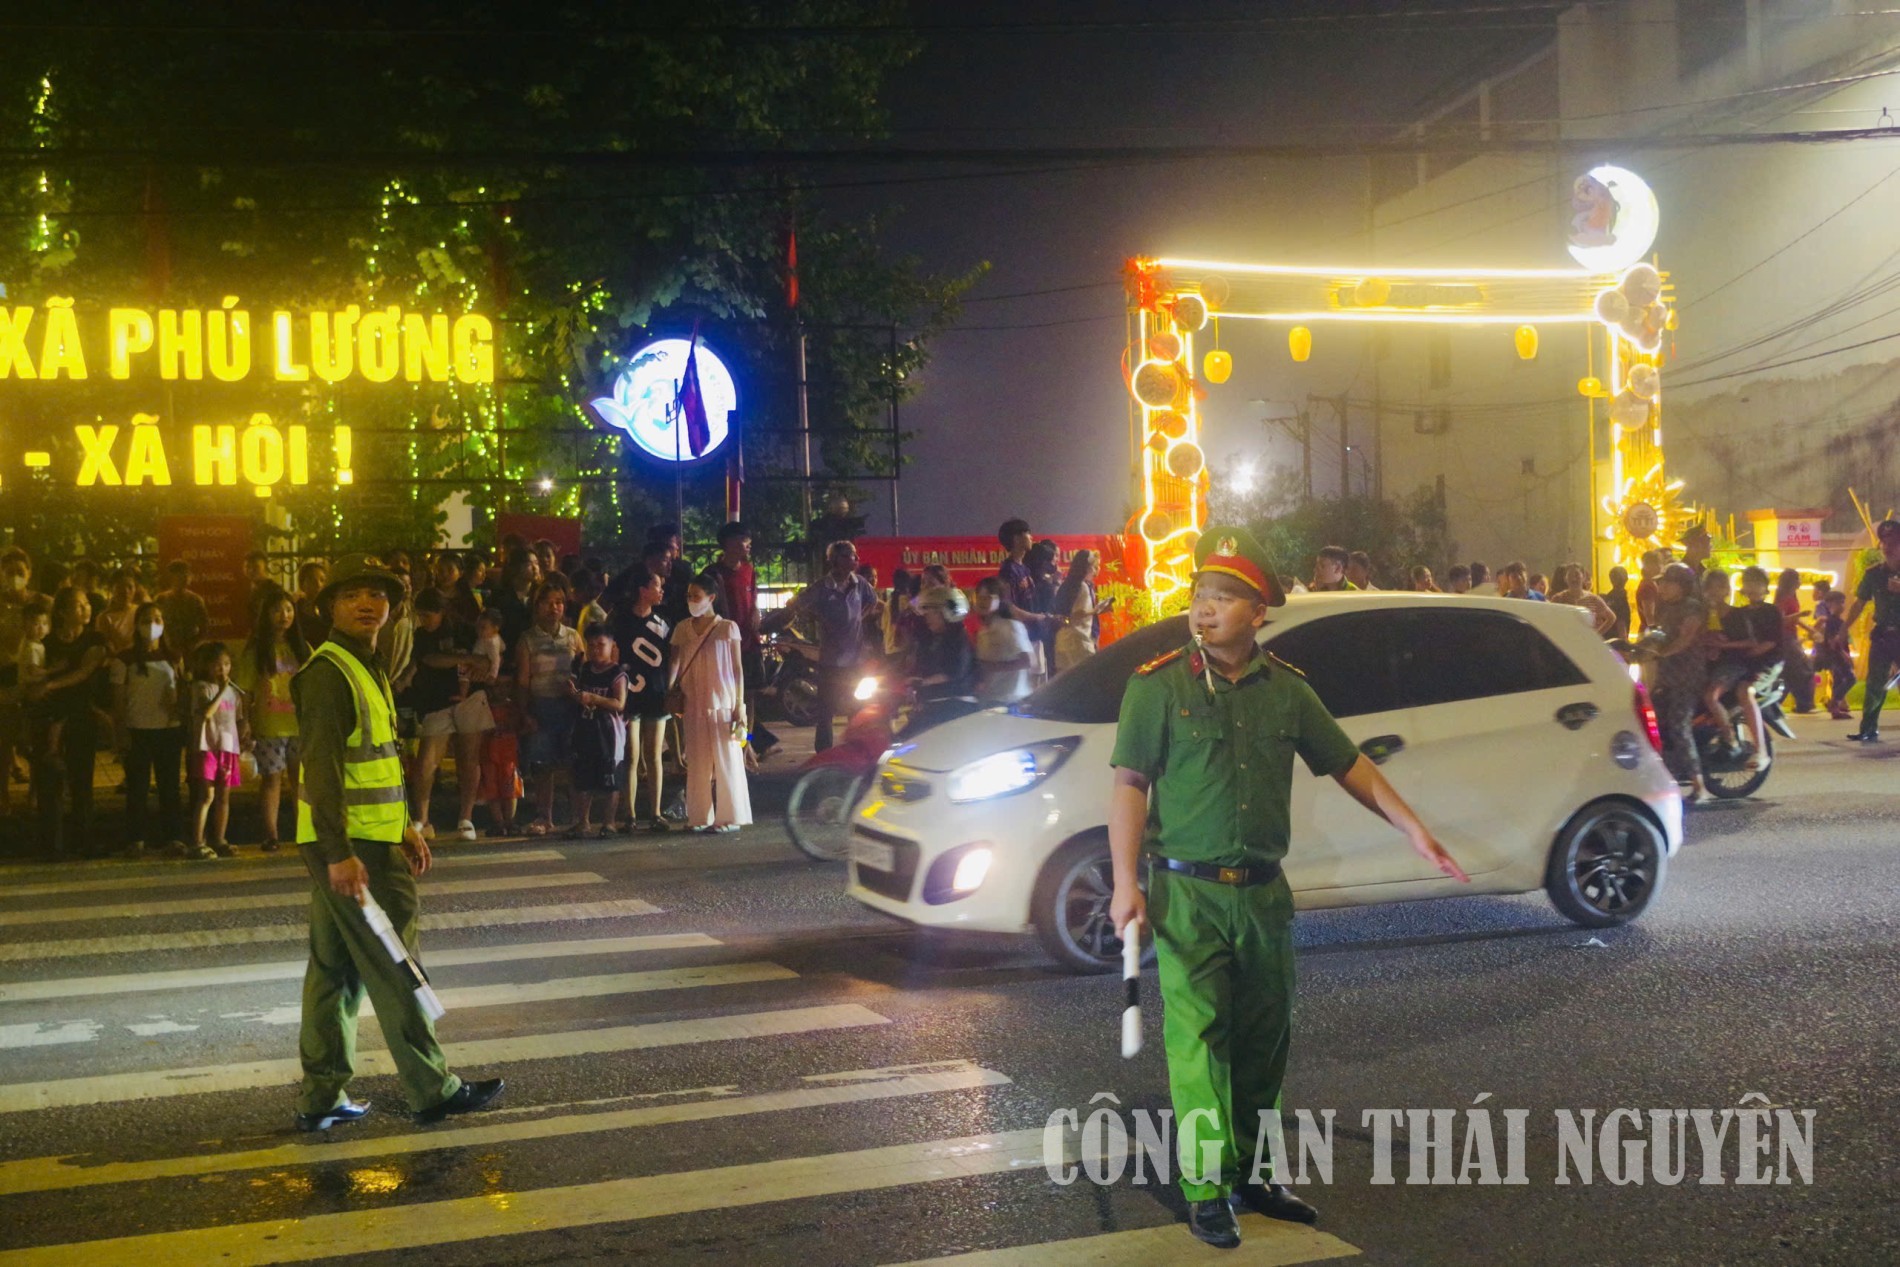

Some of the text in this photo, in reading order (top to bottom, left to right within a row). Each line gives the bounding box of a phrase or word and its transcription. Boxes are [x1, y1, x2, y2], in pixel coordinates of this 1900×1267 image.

[0, 296, 494, 384] XÃ PHÚ LƯƠNG
[75, 413, 171, 486] XÃ
[193, 412, 308, 497] HỘI
[922, 550, 948, 565] BAN
[952, 547, 987, 564] NHÂN
